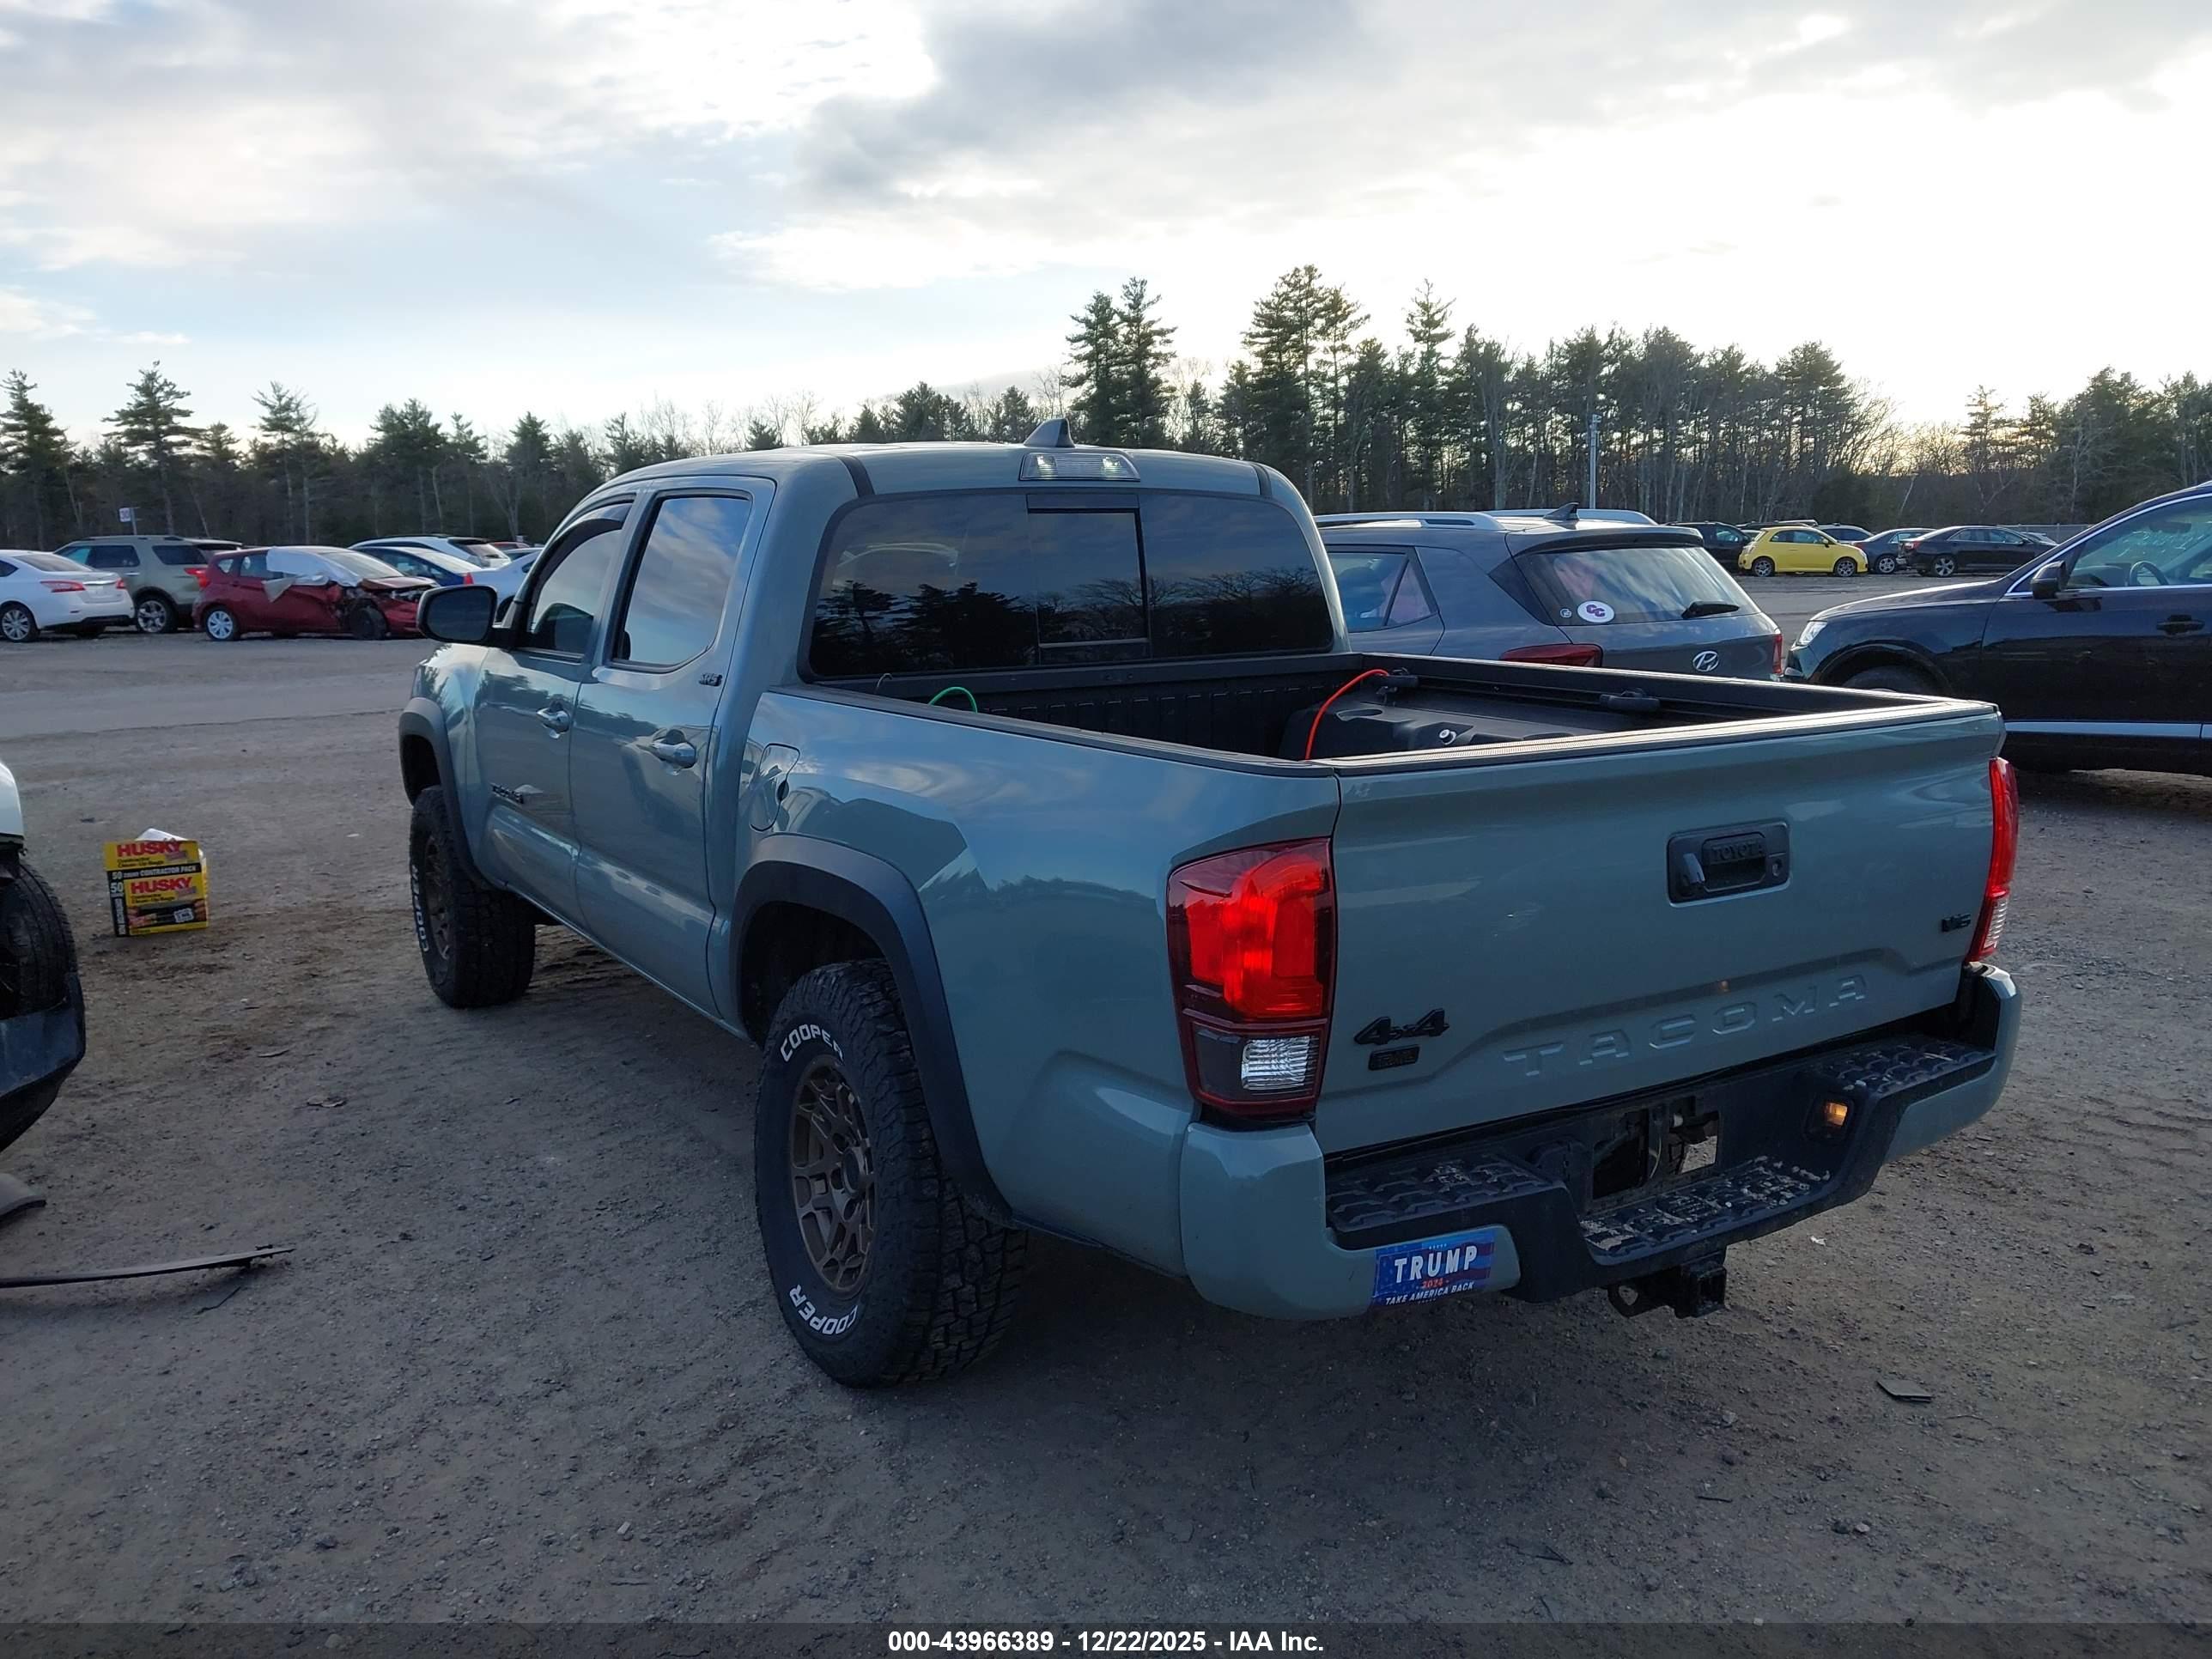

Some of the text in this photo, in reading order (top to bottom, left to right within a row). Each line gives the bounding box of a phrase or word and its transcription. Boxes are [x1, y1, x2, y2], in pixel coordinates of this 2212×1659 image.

[117, 841, 181, 857] HUSKY
[112, 871, 123, 880] 50
[131, 877, 192, 894] HUSKY
[110, 882, 124, 893] 50
[1503, 974, 1867, 1077] TACOMA
[780, 1024, 844, 1062] COOPER
[1394, 1245, 1478, 1284] TRUMP
[1385, 1281, 1475, 1305] TAKE AMERICA BACK
[1422, 1277, 1443, 1289] 2024
[789, 1284, 859, 1335] COOPER
